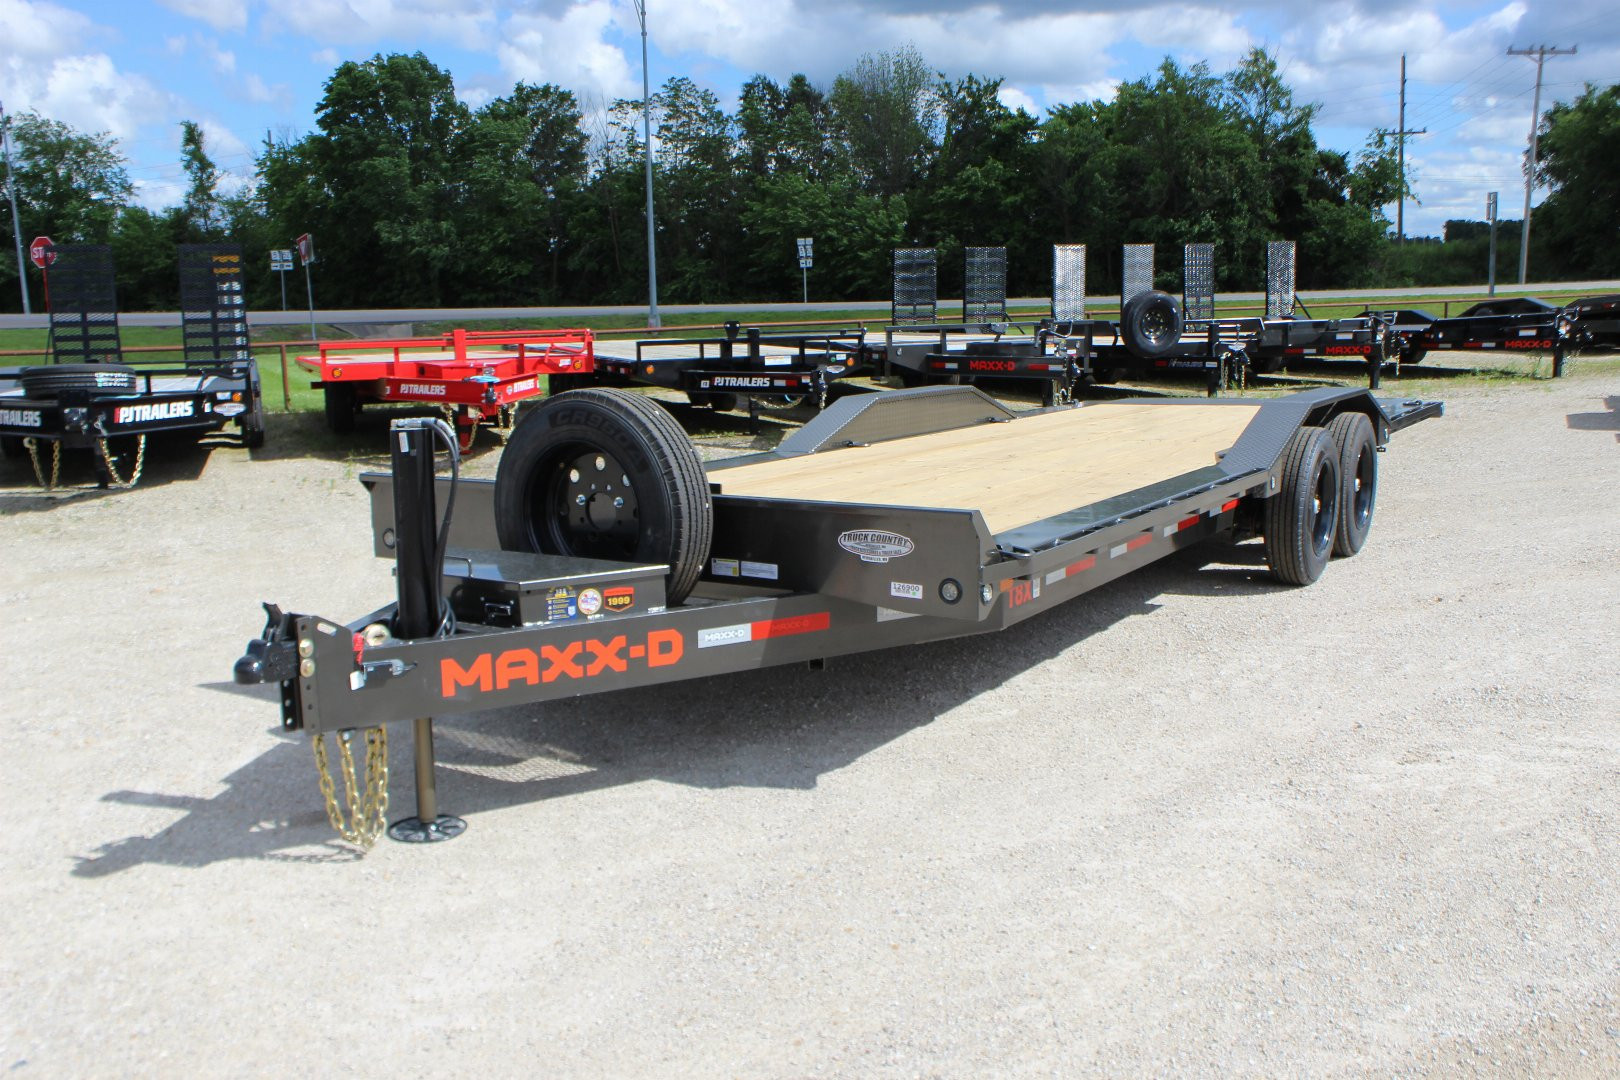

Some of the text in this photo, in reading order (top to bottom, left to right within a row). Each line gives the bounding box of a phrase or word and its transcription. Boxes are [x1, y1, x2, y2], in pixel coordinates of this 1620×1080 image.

[1325, 345, 1372, 354] MAXX-D
[1505, 340, 1552, 348] MAXX-D
[969, 361, 1016, 371] MAXX-D
[843, 533, 869, 542] TRUCK
[870, 533, 909, 547] COUNTRY
[1009, 580, 1032, 608] T8X
[608, 595, 631, 606] 1999
[705, 629, 745, 641] MAXX-D
[440, 628, 684, 698] MAXX-D
